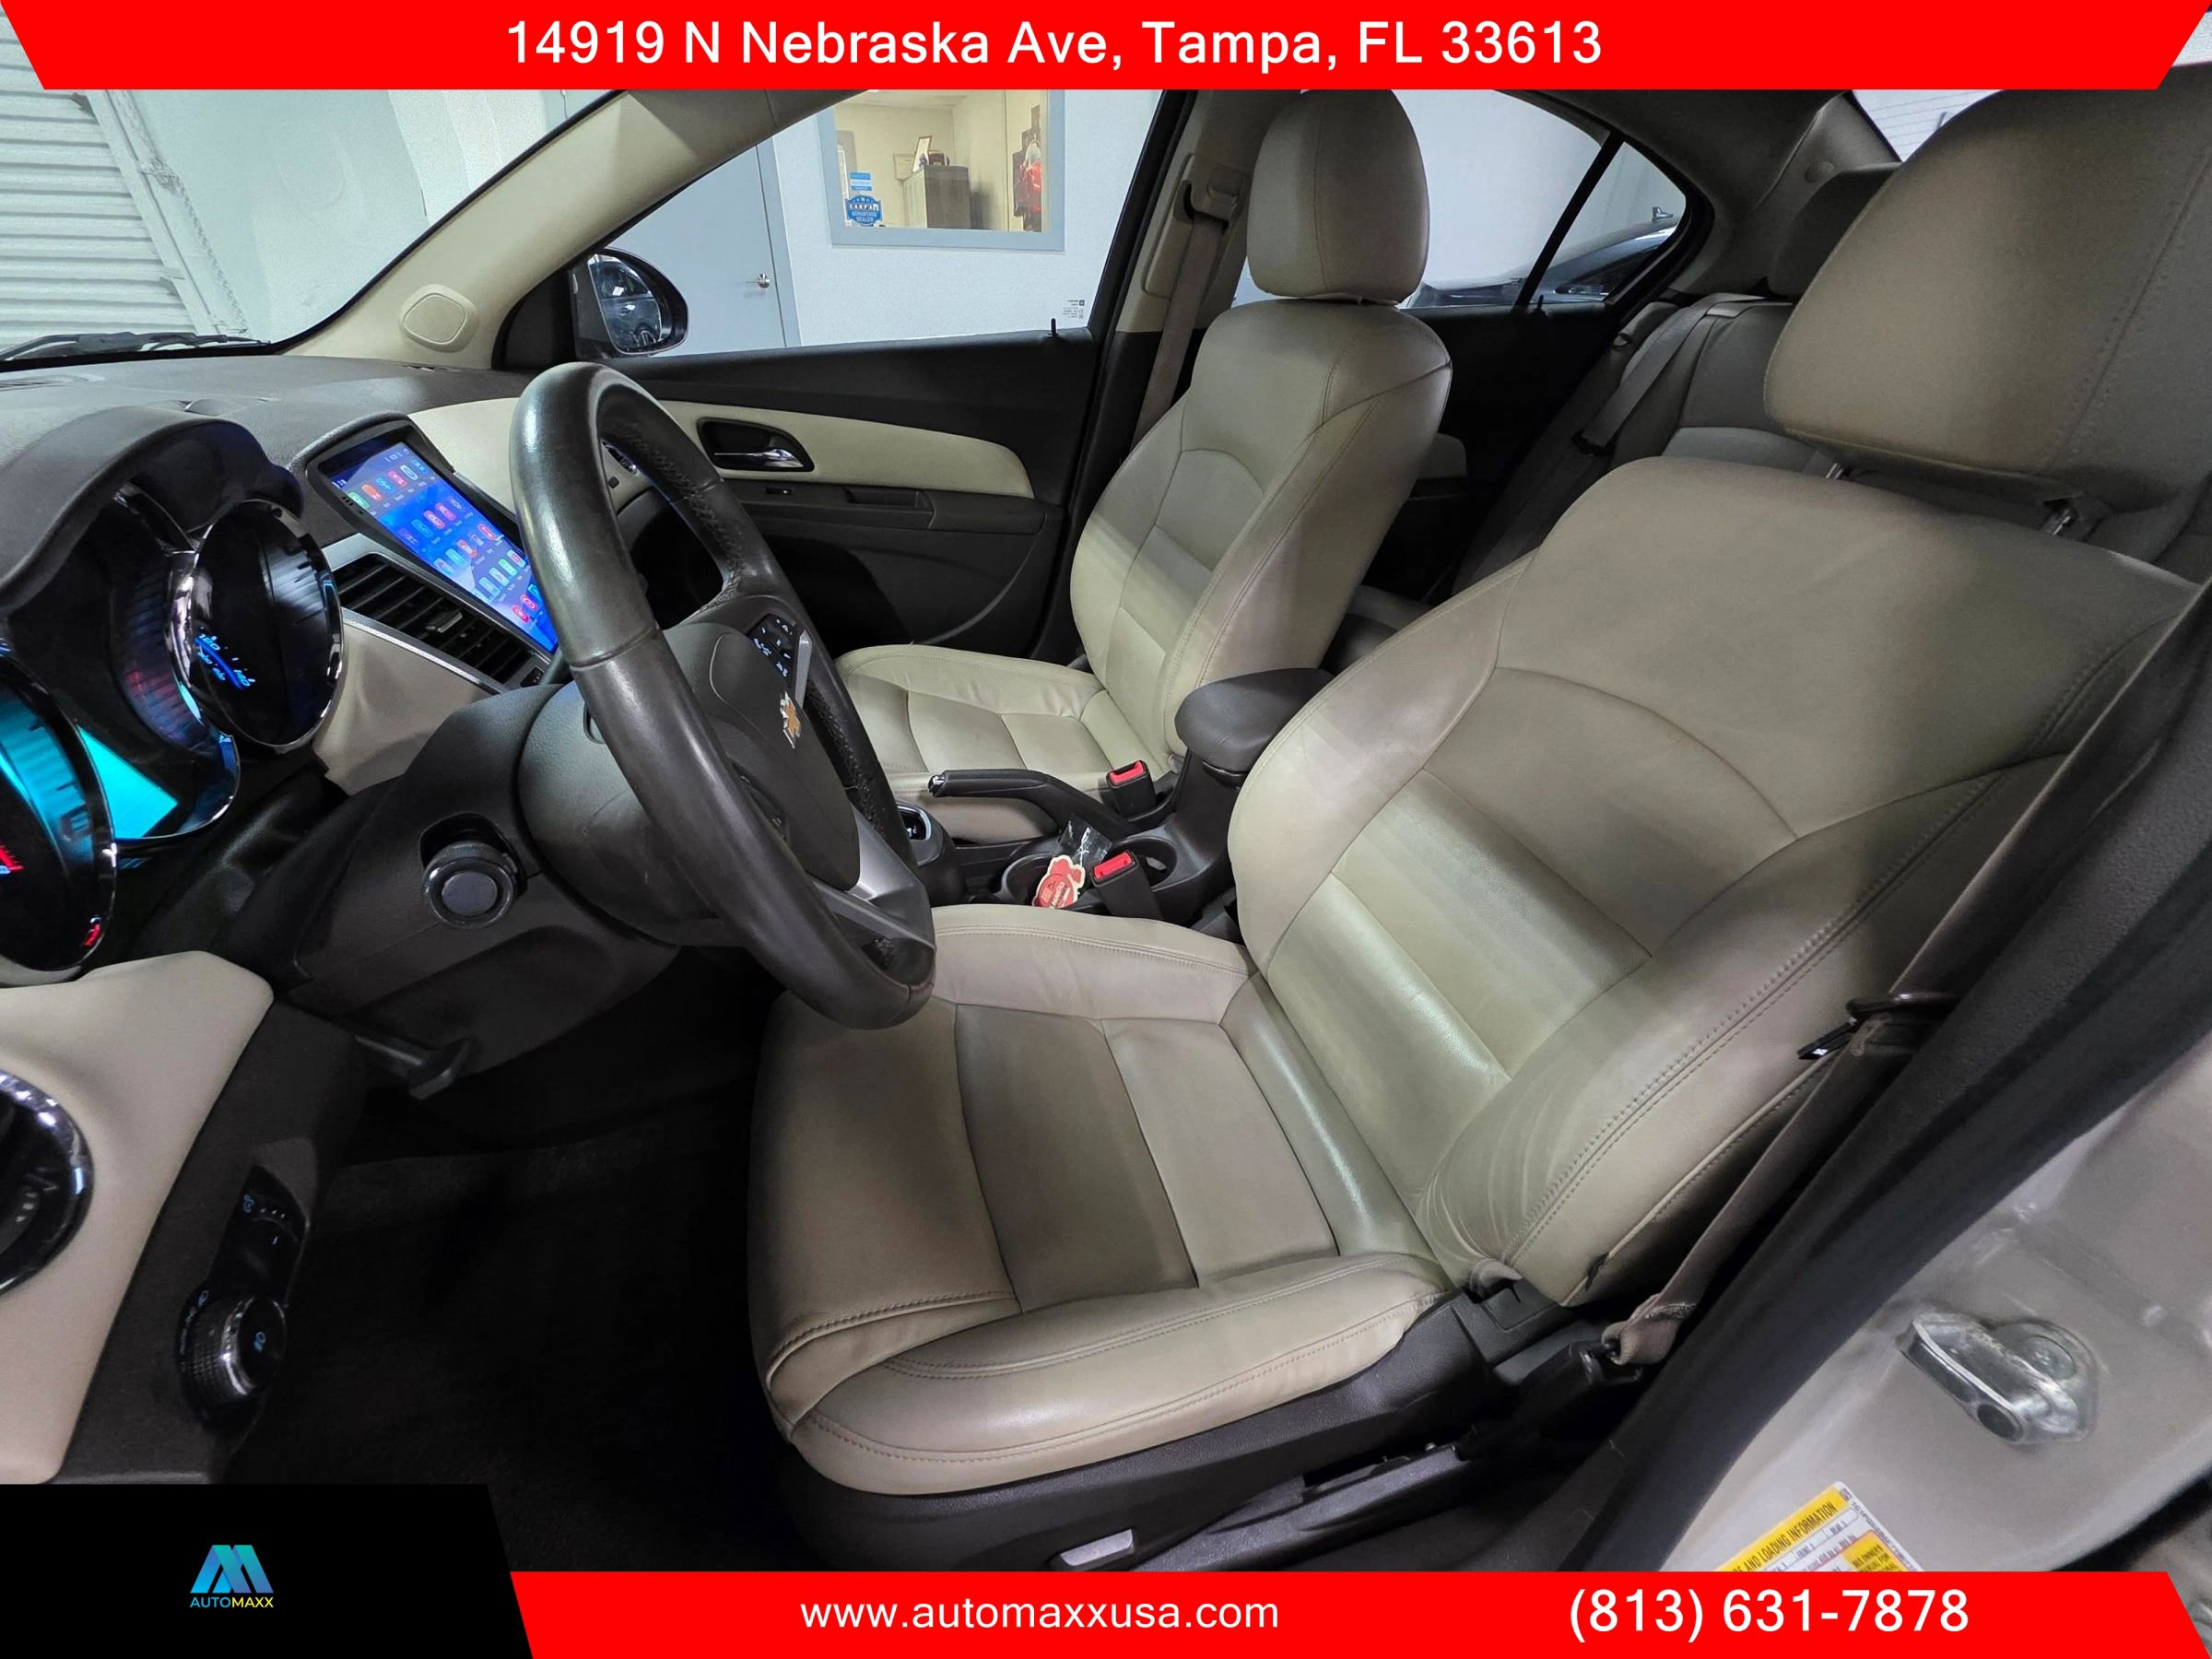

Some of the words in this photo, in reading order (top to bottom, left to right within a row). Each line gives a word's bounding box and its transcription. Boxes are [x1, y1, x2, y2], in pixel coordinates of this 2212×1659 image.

[1743, 1555, 1762, 1571] AND
[1758, 1534, 1792, 1562] LOADING
[1786, 1501, 1838, 1542] INFORMATION
